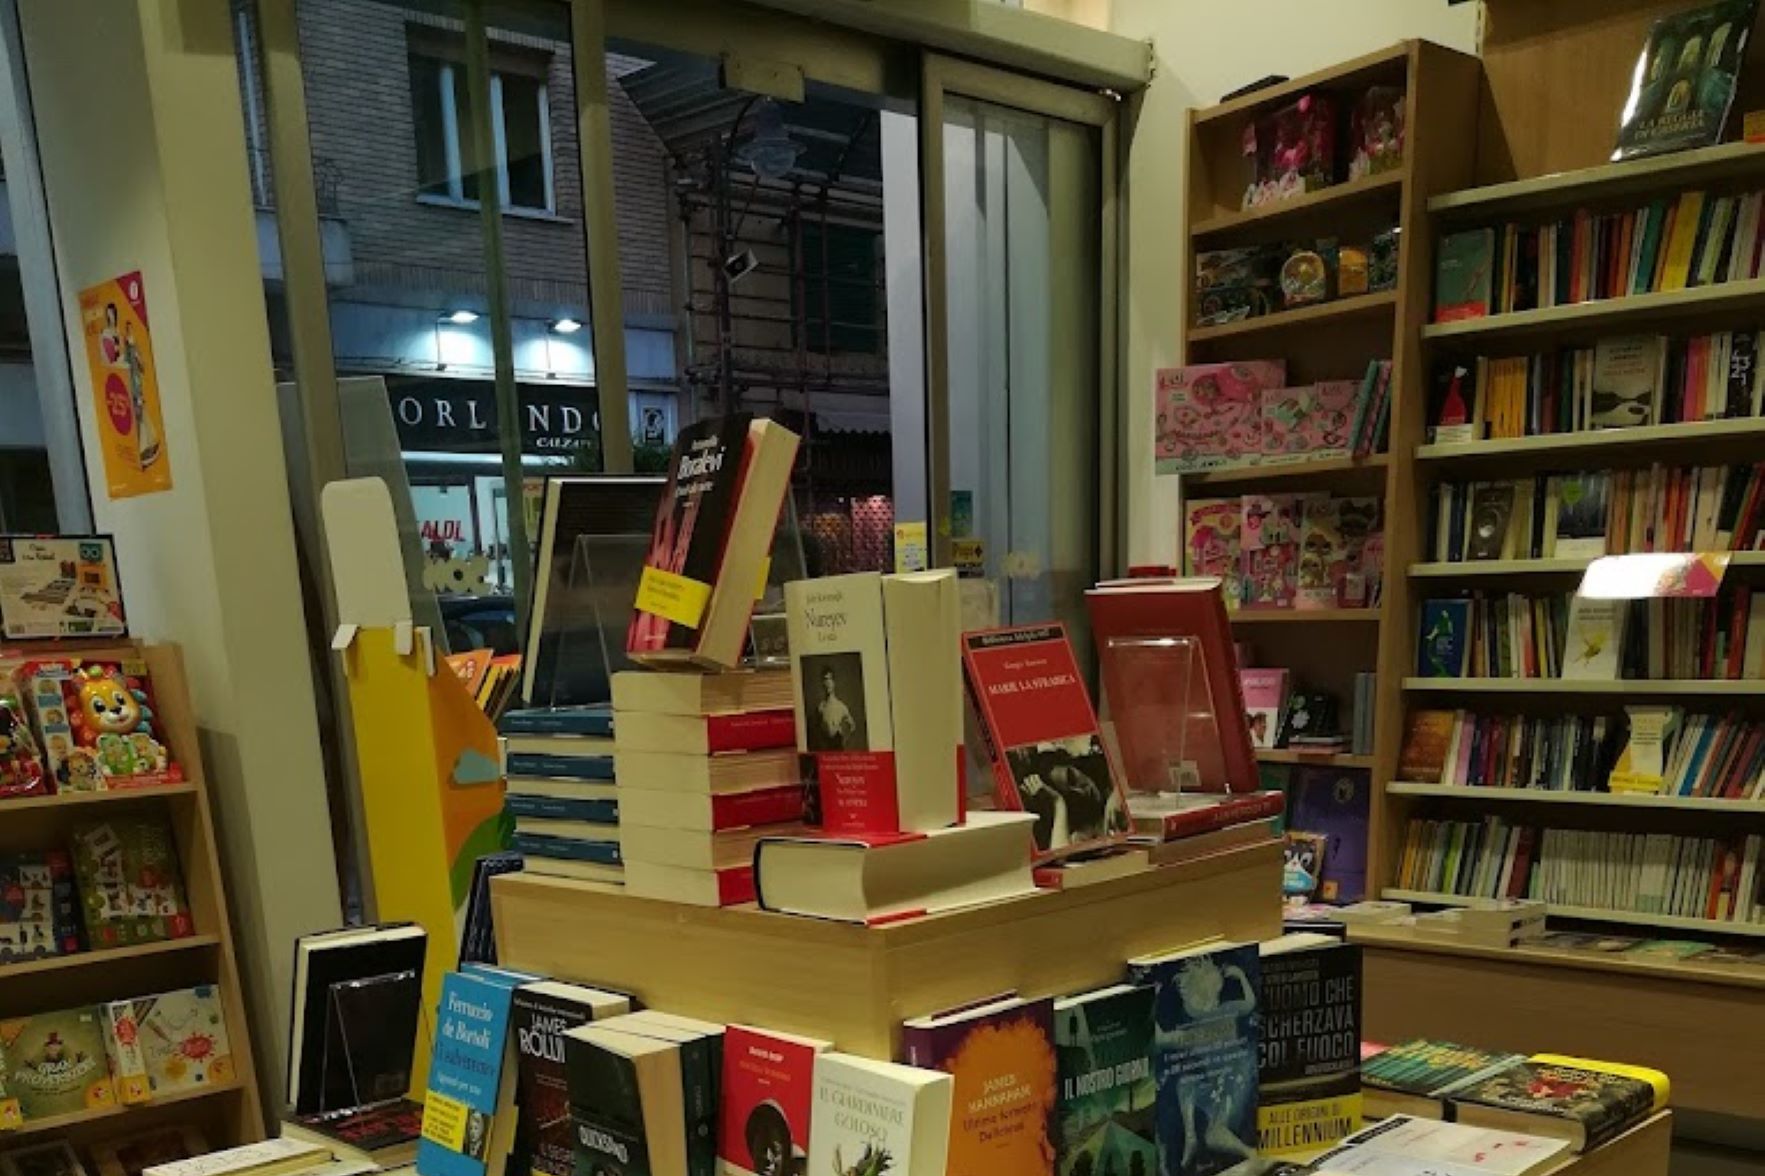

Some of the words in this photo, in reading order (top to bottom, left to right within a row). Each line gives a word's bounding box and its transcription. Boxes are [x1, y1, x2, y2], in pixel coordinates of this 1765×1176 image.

[399, 397, 600, 434] ORLND
[420, 520, 466, 543] ALDI
[1325, 975, 1354, 1004] CHE
[1297, 1031, 1355, 1063] FUOCO
[1064, 1077, 1075, 1101] IL
[1256, 1116, 1352, 1151] MILLENNIUM
